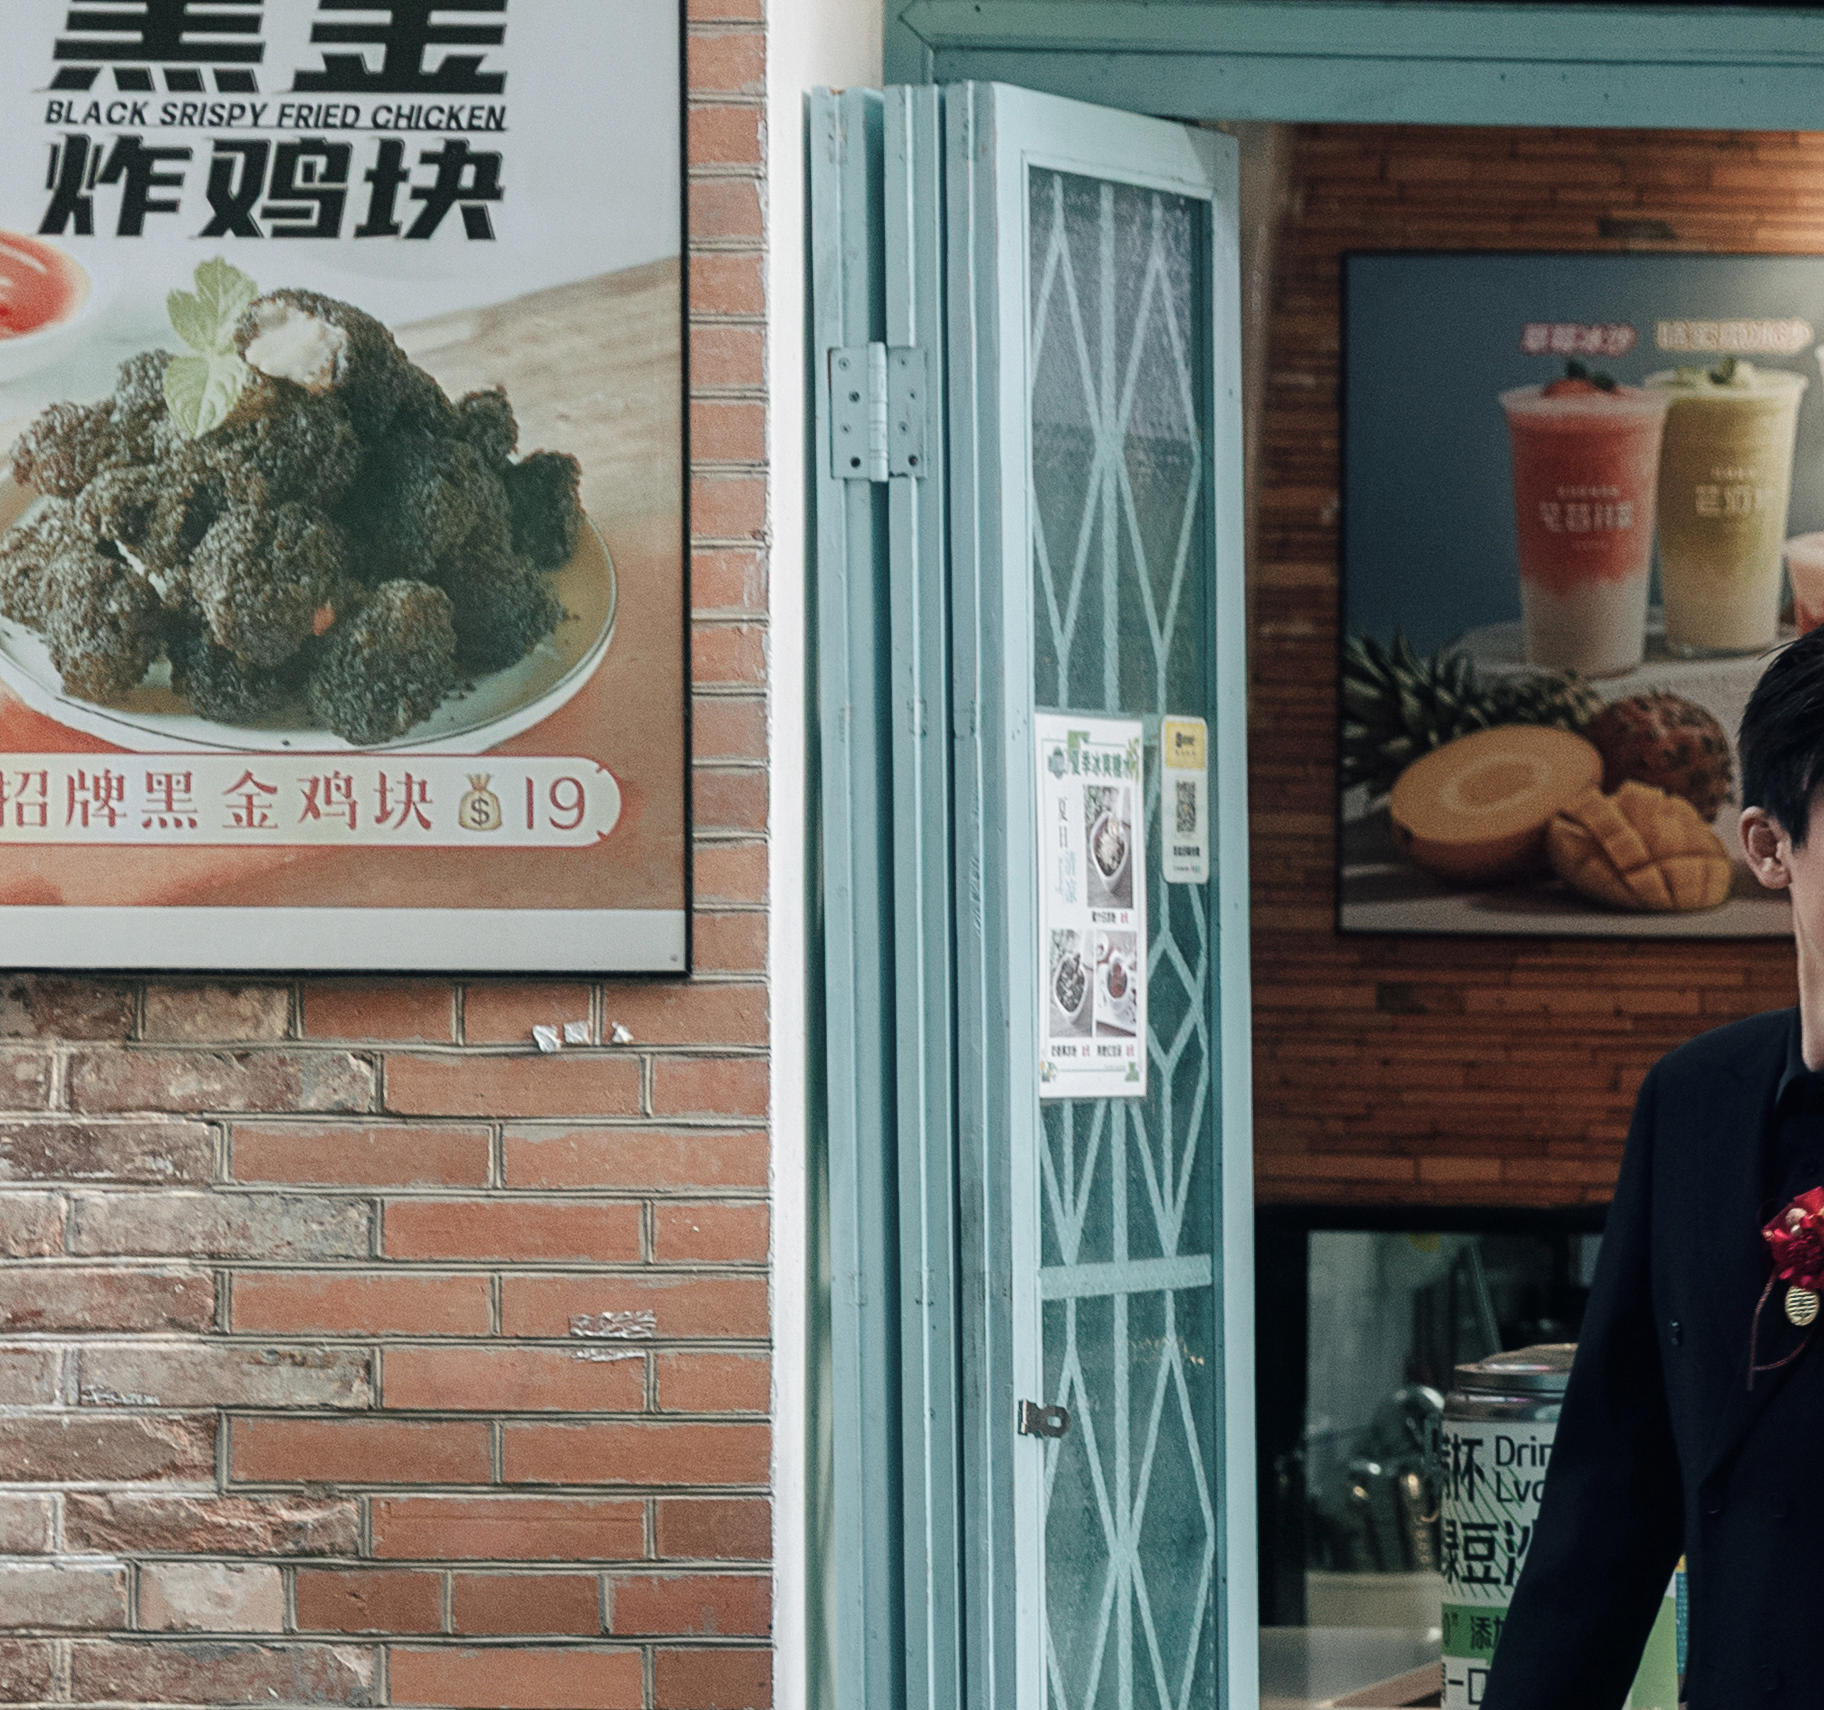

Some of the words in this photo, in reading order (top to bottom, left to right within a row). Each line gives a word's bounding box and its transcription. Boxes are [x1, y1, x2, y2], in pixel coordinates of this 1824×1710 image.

[45, 101, 148, 126] BLACK
[159, 103, 268, 128] SRISPY
[277, 105, 361, 130] FRIED
[371, 106, 507, 131] CHICKEN
[38, 133, 505, 240] 炸鸡块
[0, 769, 434, 832] 招牌黑金鸡块
[526, 776, 587, 831] 19
